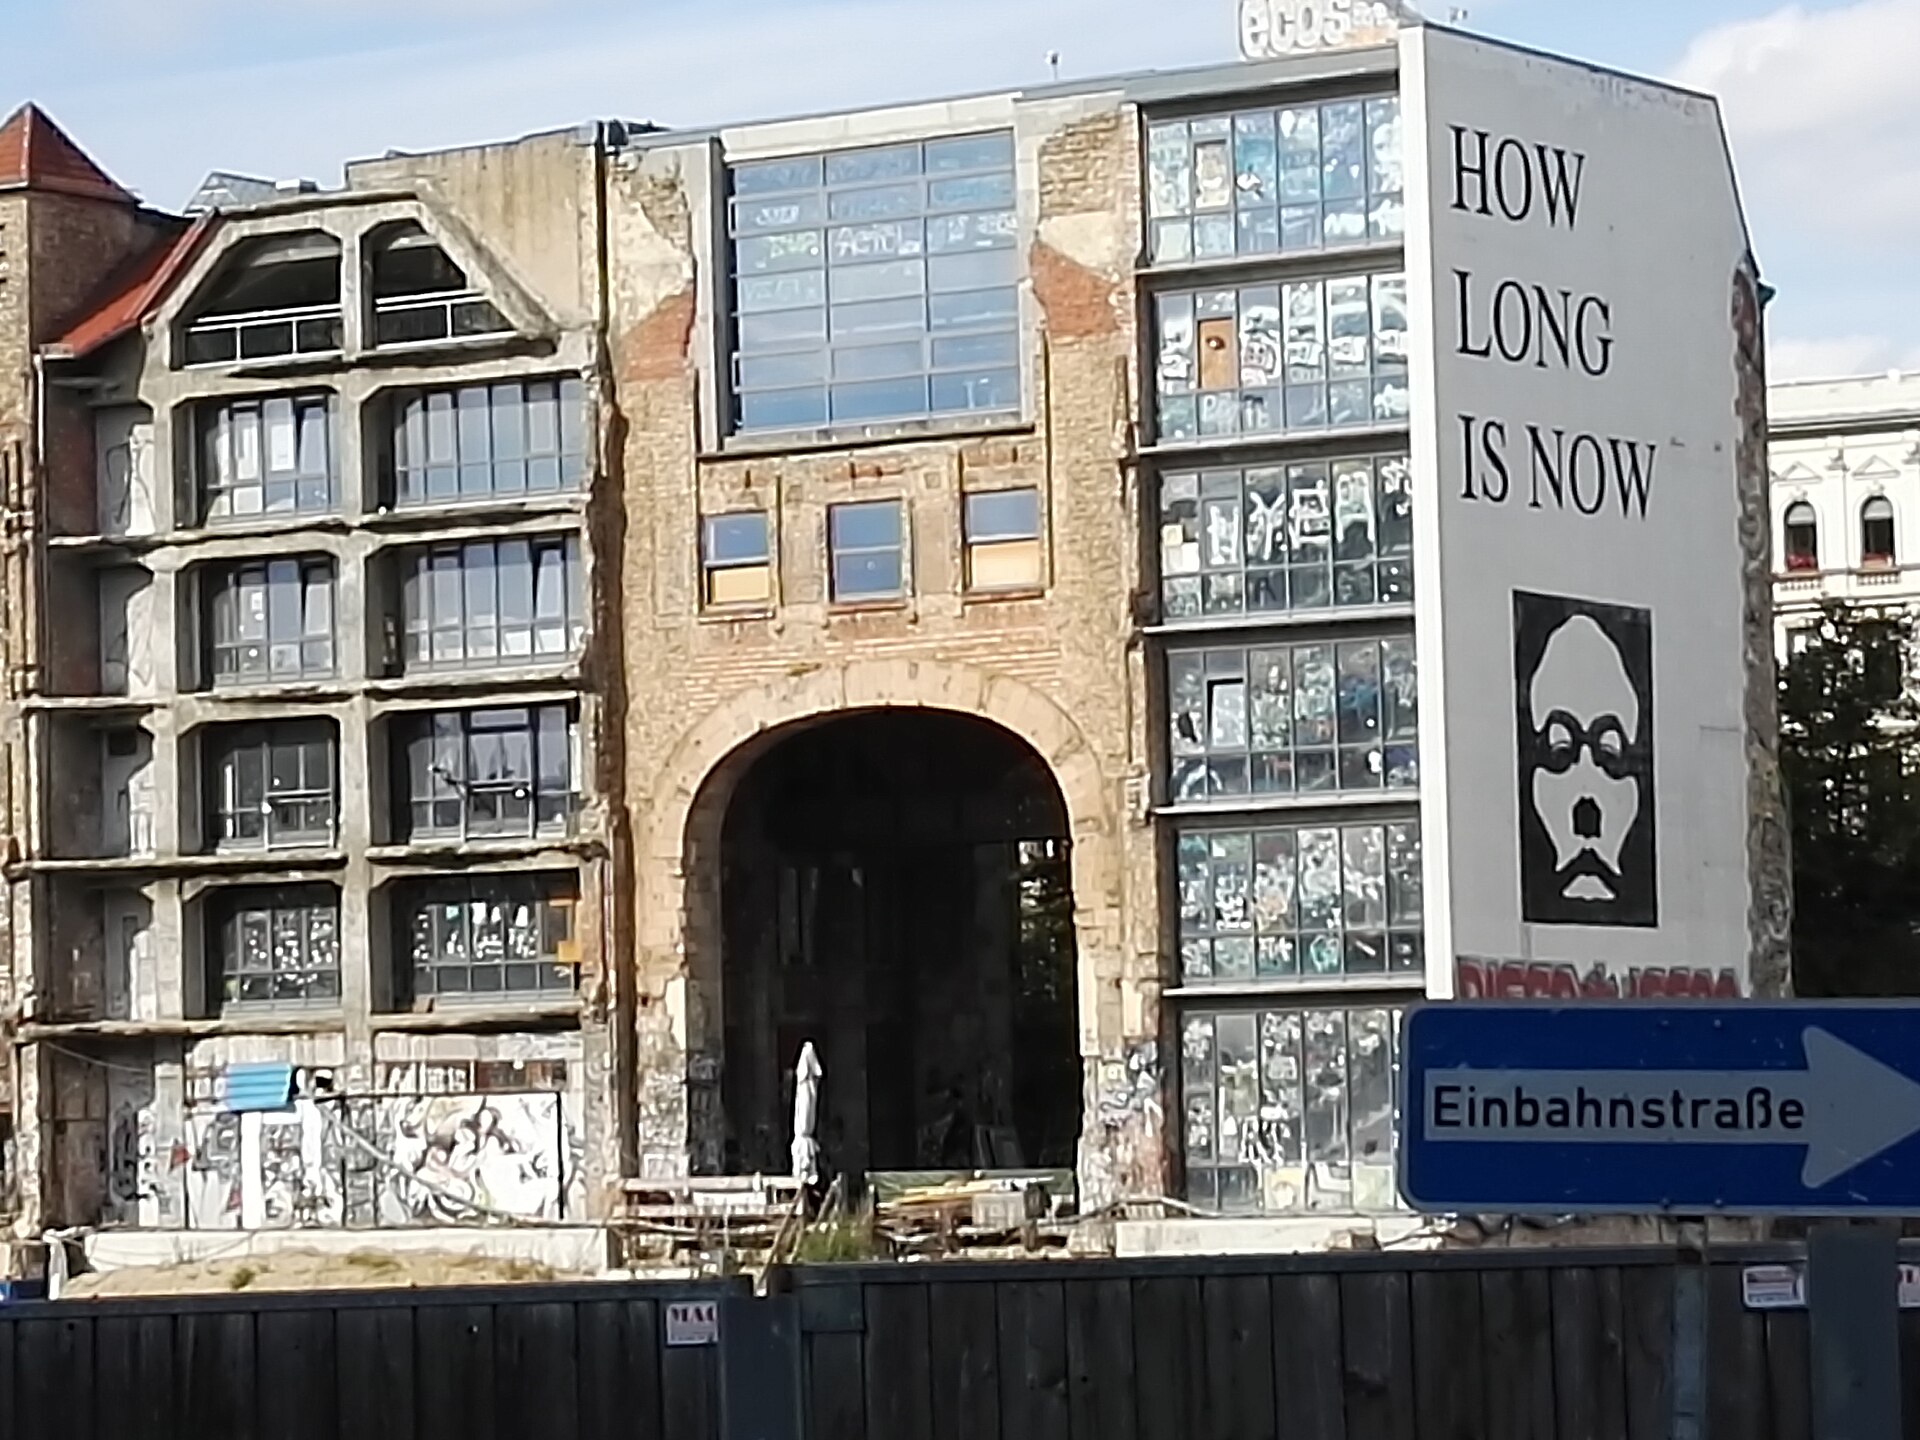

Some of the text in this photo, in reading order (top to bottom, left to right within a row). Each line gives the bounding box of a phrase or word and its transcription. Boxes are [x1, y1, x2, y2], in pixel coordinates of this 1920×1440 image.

[1448, 124, 1585, 231] HOW
[1453, 269, 1613, 376] LONG
[1459, 414, 1656, 521] IS NOW
[1433, 1085, 1804, 1130] Einbahnstraße
